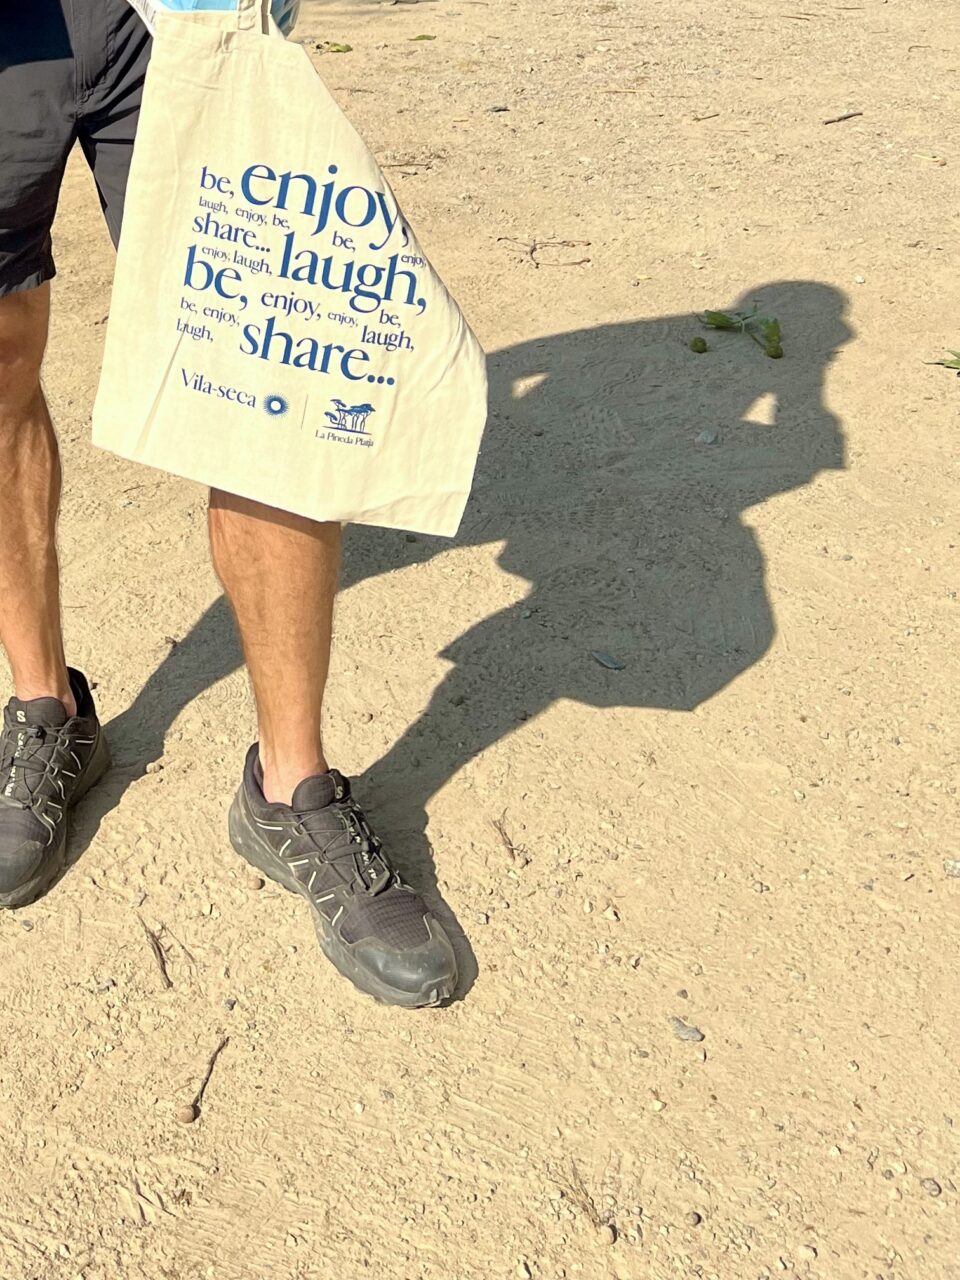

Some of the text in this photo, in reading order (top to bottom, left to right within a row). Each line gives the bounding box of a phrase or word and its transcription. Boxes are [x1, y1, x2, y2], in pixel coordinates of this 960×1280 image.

[199, 196, 290, 230] laugh, enjoy, be,
[200, 164, 409, 251] be, enjoy,
[332, 230, 356, 252] be,
[192, 212, 427, 316] share... laugh,
[202, 246, 273, 277] enjoy, laugh,
[184, 244, 401, 328] be, enjoy, enjoy, be,
[180, 297, 240, 327] be, enjoy,
[176, 316, 415, 386] laugh, share... laugh,
[181, 368, 257, 408] Vila-seca
[315, 429, 326, 439] La
